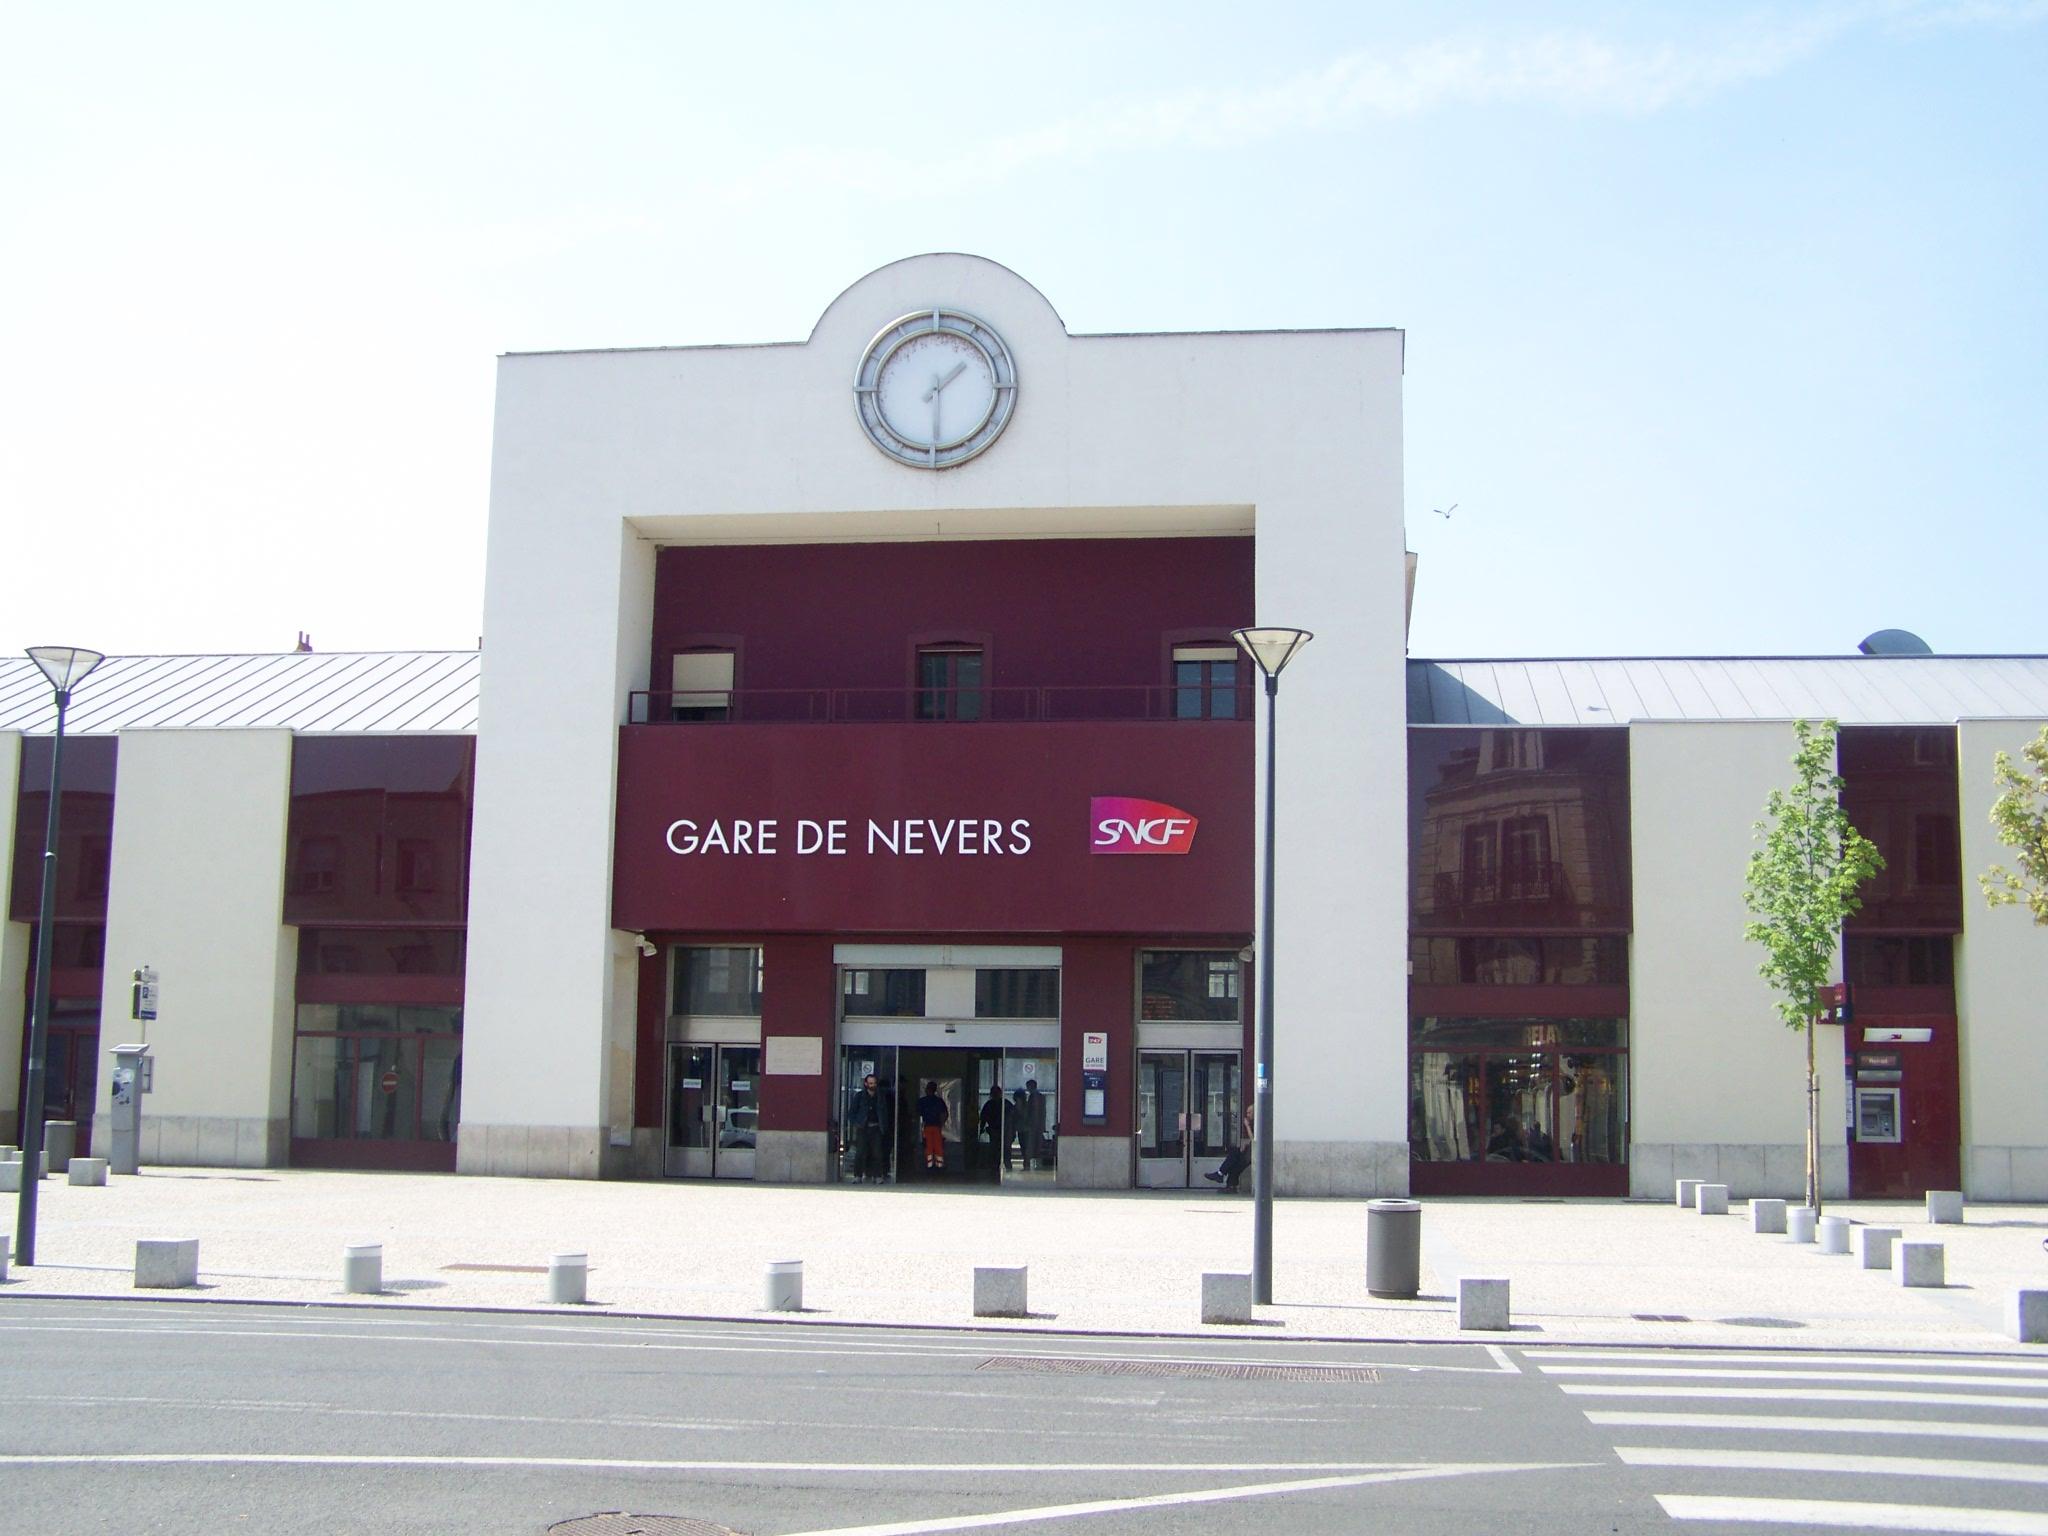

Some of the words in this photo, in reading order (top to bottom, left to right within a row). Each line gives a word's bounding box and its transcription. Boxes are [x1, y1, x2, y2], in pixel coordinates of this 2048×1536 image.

[666, 819, 777, 855] GARE
[797, 820, 847, 855] DE
[868, 819, 1032, 855] NEVERS
[1094, 818, 1191, 845] SNCF
[1085, 1056, 1104, 1064] GARE
